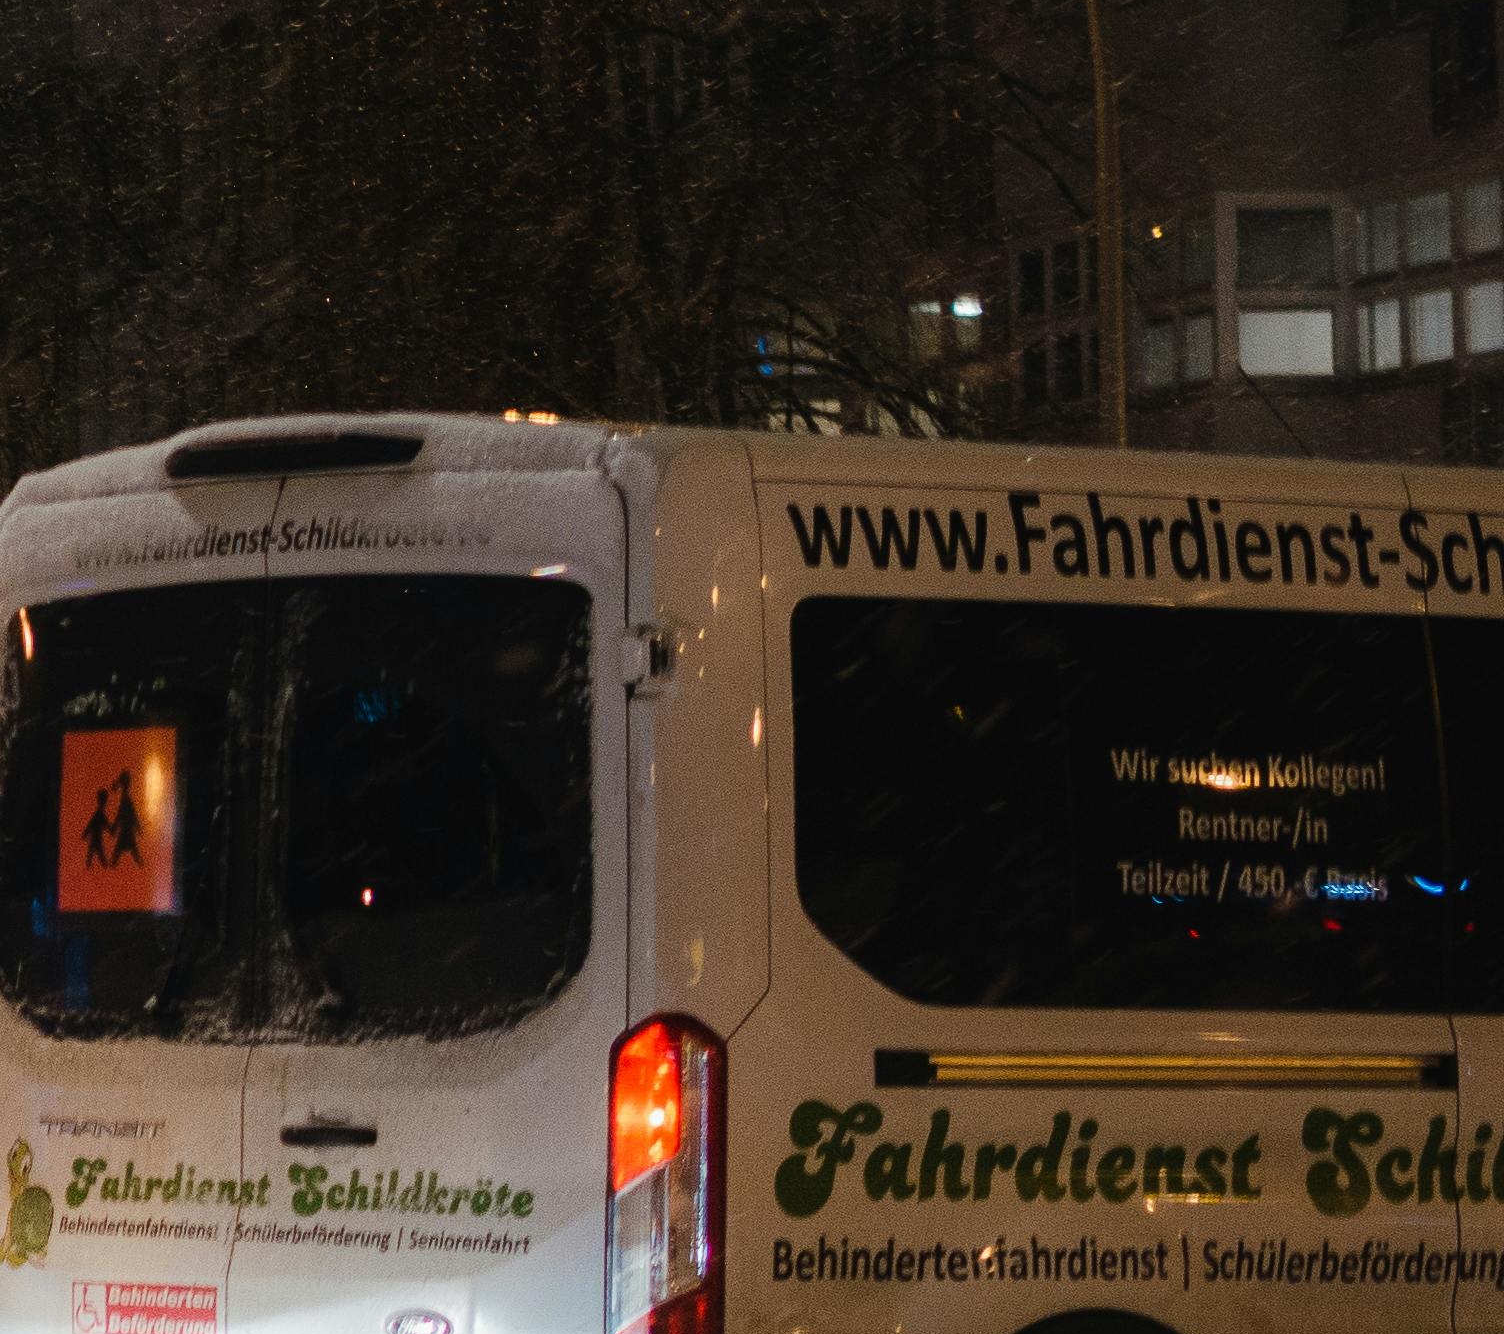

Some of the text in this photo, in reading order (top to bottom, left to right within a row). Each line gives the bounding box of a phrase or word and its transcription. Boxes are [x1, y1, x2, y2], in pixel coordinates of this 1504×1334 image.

[1111, 746, 1386, 796] Wir suchen Kollegen!
[1178, 806, 1329, 849] Rentner-/in
[1117, 859, 1210, 897] Teilzeit
[774, 1099, 1261, 1218] Fahrdienst
[65, 1156, 535, 1219] Fahrdienst Schildkröte
[59, 1214, 531, 1256] Behindertenfahrdienst Schülerbeförderung Seniorenfahrt
[772, 1233, 1169, 1283] Behindertenfahrdienst
[109, 1285, 217, 1310] Behinderten
